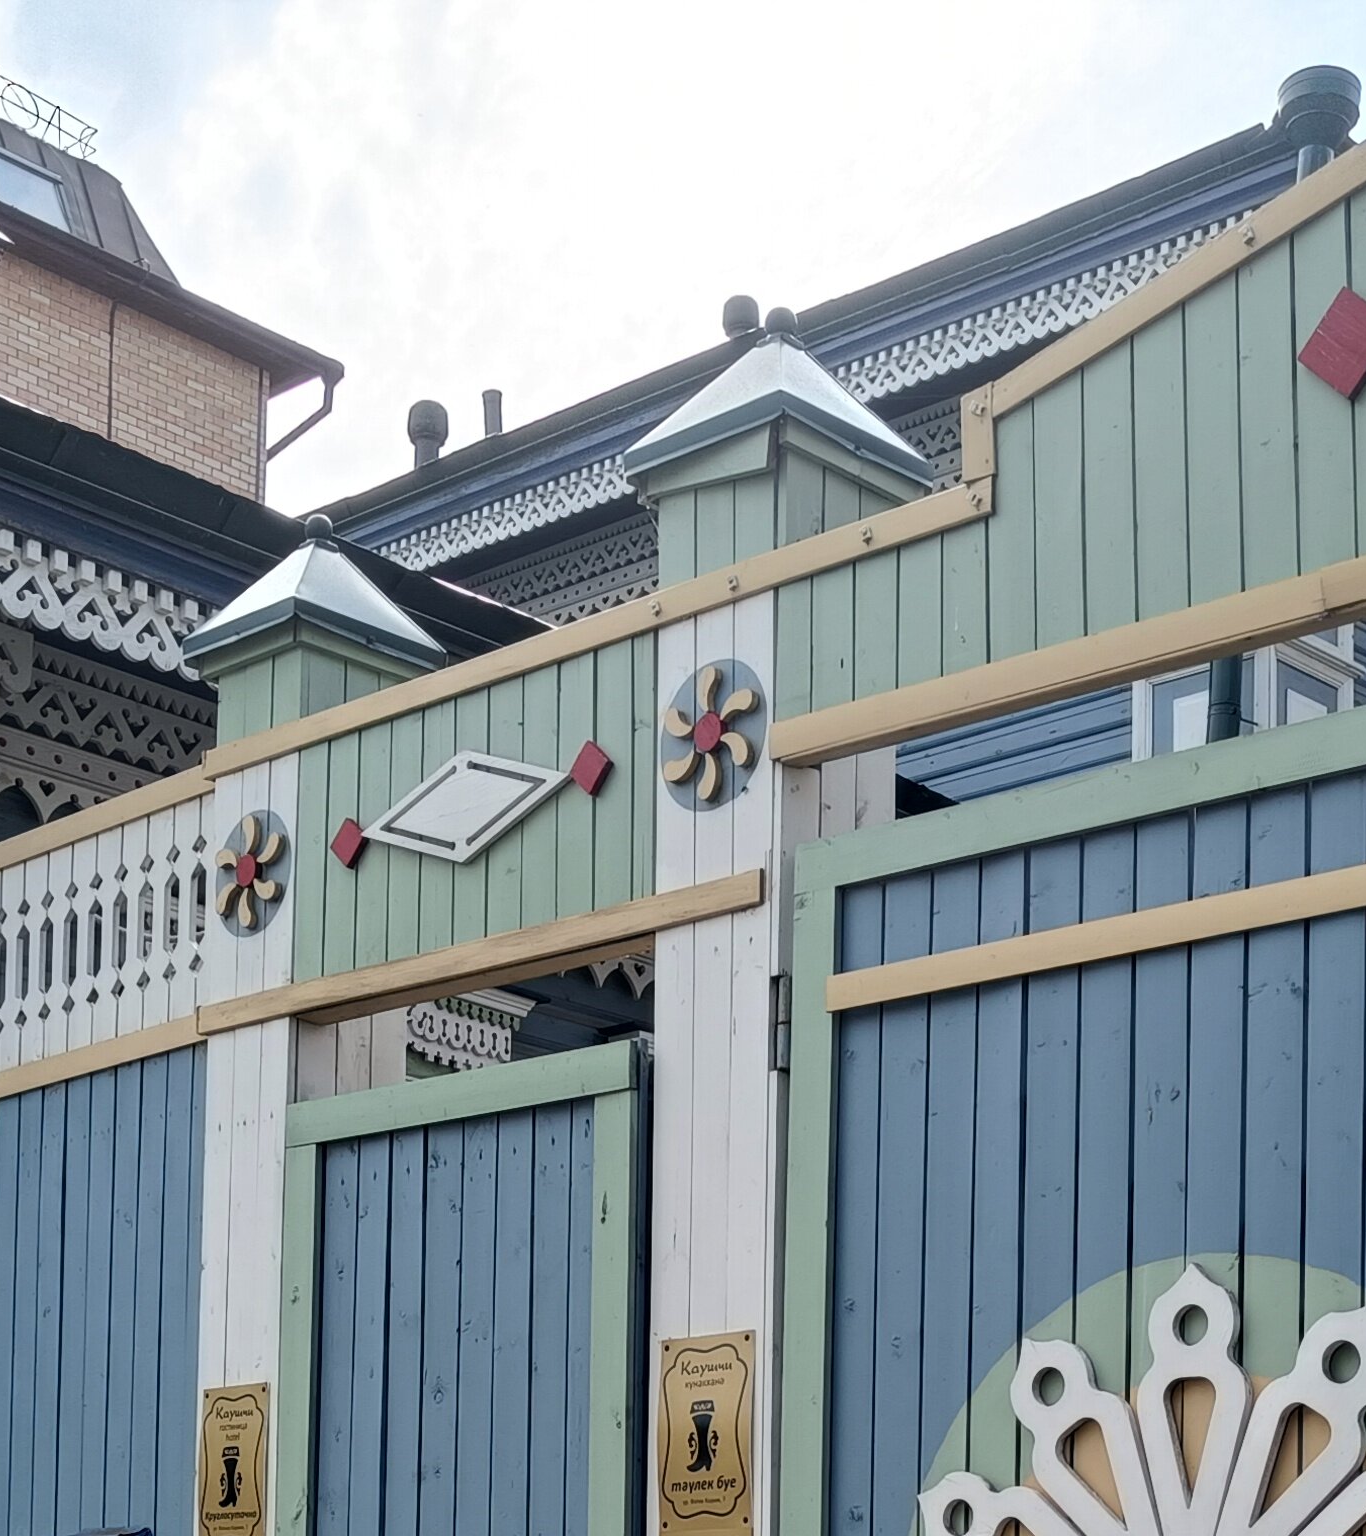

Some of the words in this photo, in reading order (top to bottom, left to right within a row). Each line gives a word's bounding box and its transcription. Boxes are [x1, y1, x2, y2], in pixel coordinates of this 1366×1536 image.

[681, 1360, 732, 1378] Каушчи
[215, 1406, 254, 1422] Каушчи
[717, 1475, 737, 1492] буе
